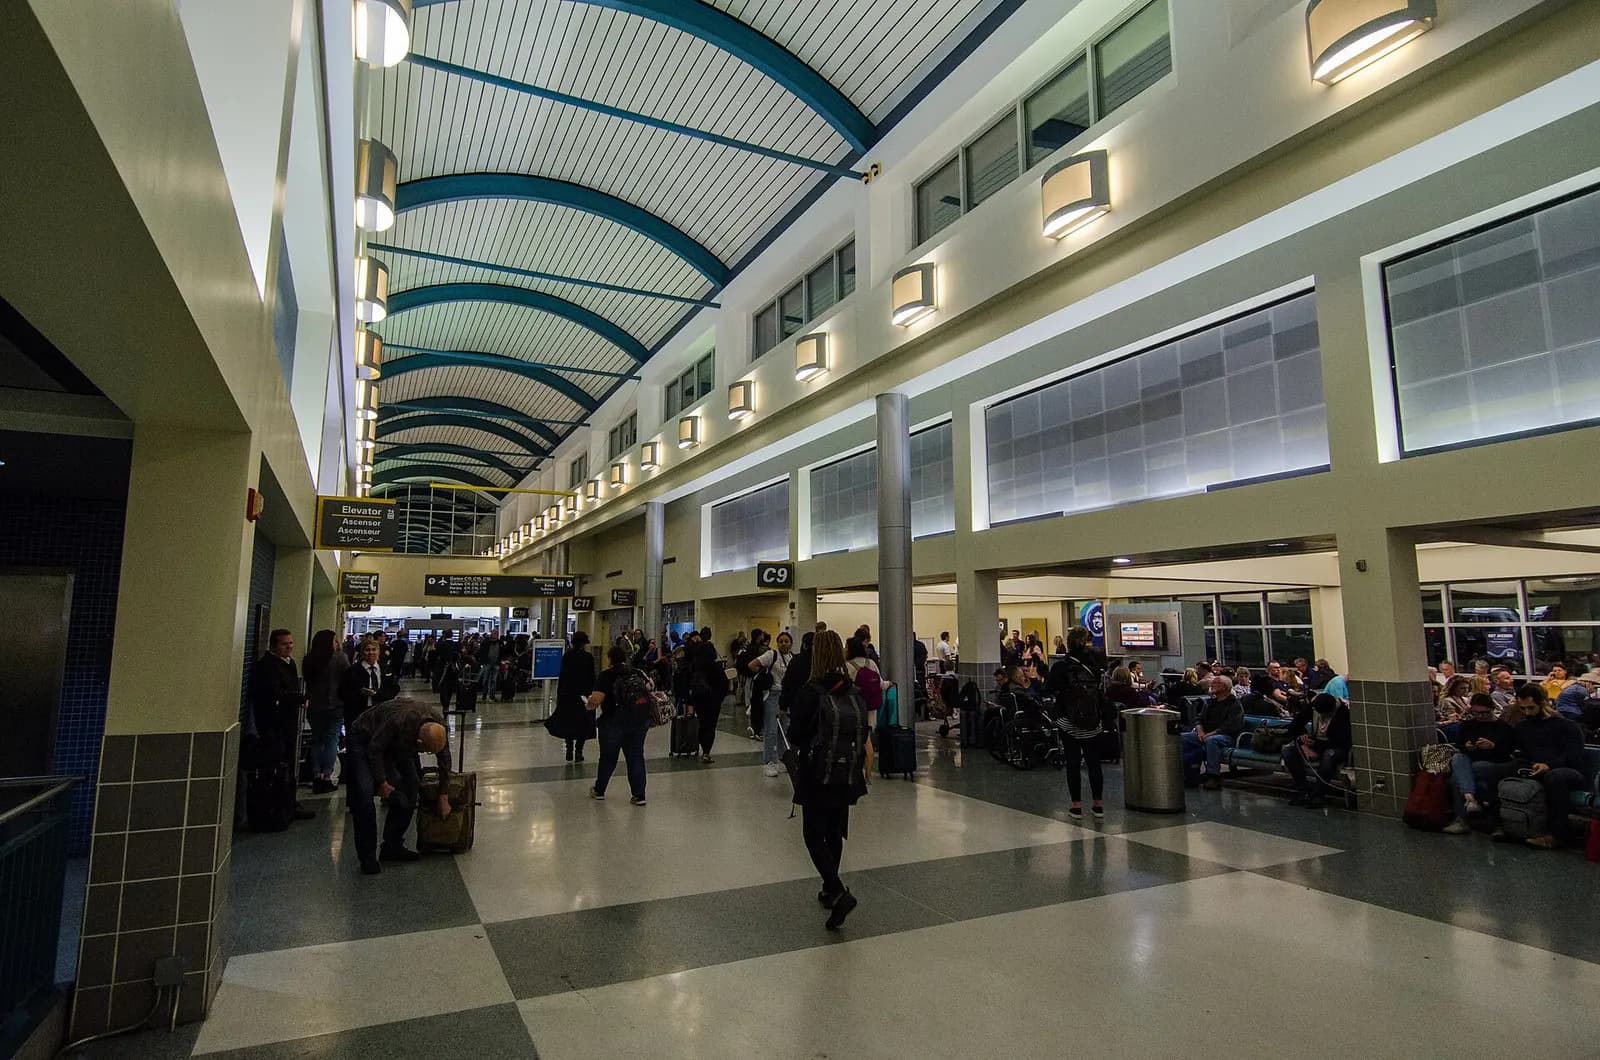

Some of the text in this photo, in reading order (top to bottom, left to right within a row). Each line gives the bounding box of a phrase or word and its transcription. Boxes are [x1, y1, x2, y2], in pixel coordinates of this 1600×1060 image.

[342, 505, 382, 515] Elevator
[342, 518, 382, 526] Ascensor
[337, 526, 381, 535] Ascenseur
[763, 567, 788, 583] C9
[574, 598, 591, 607] C11
